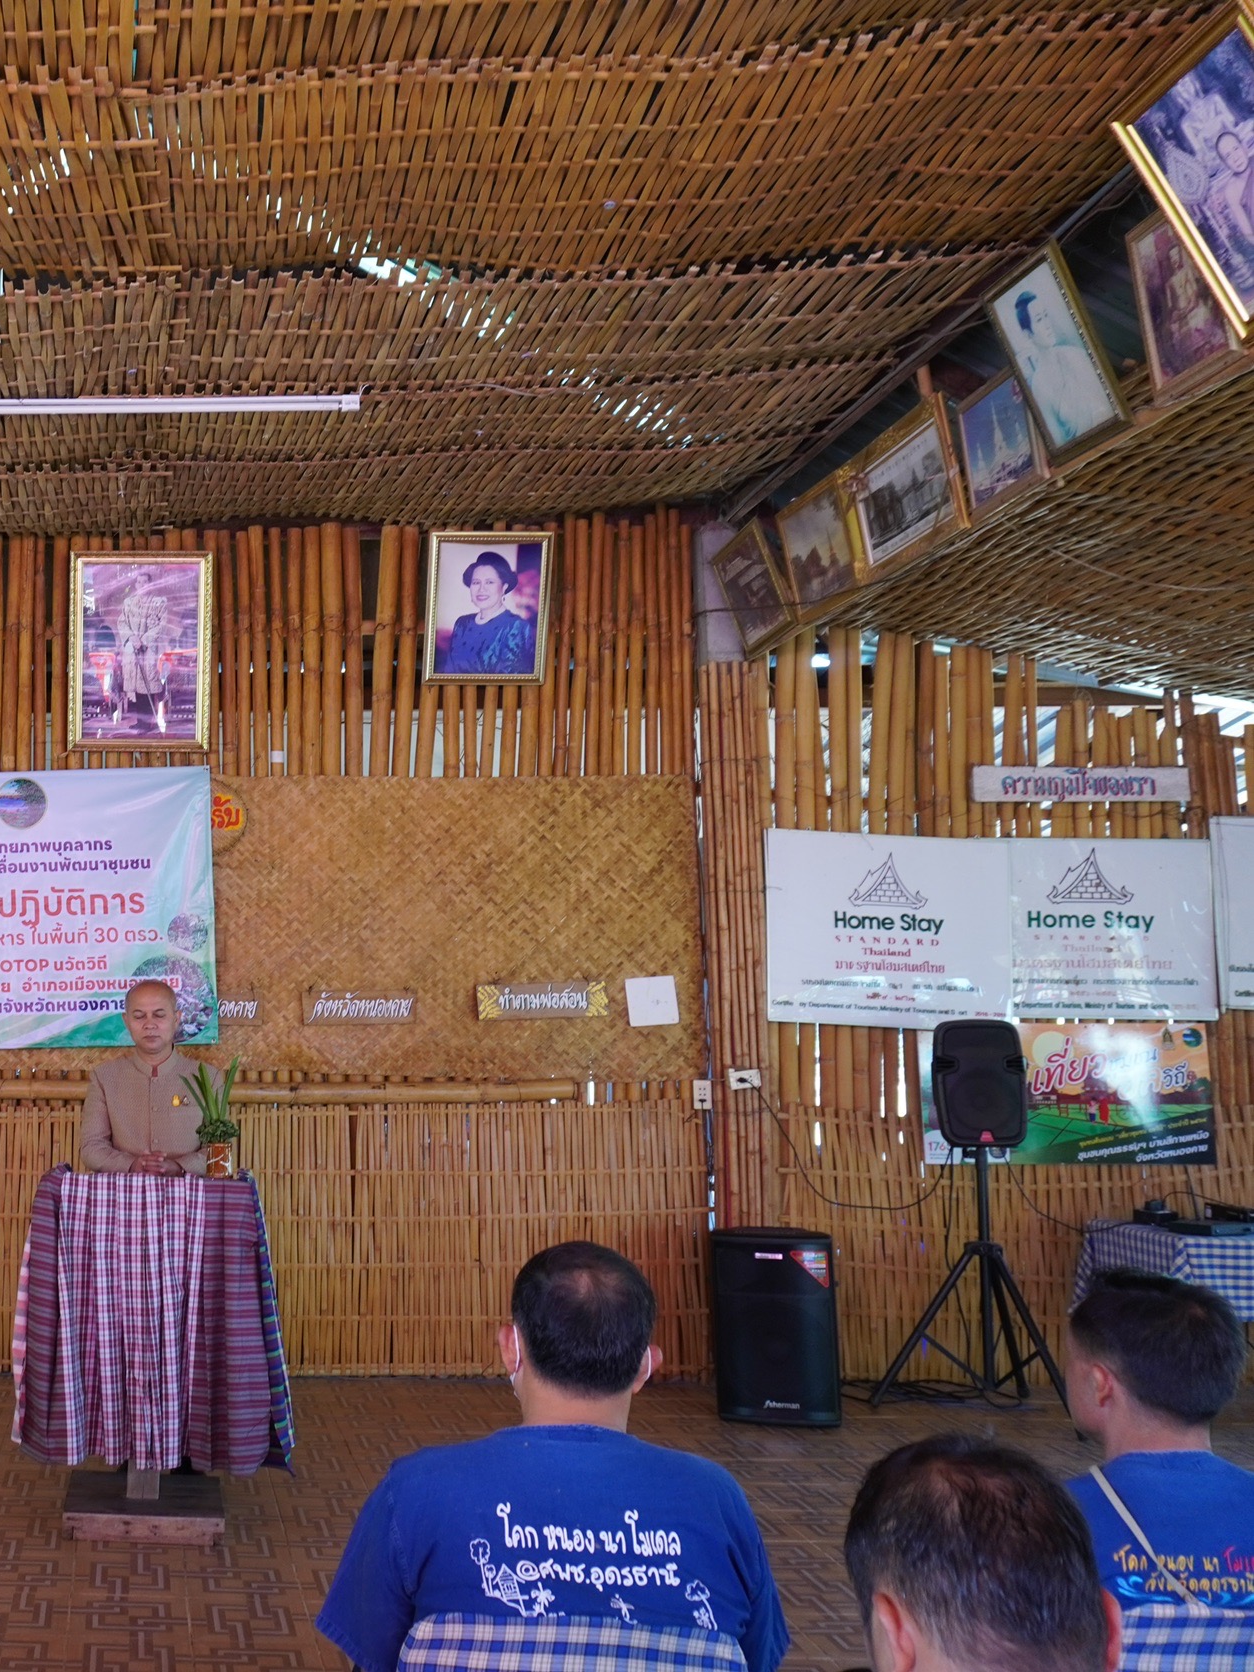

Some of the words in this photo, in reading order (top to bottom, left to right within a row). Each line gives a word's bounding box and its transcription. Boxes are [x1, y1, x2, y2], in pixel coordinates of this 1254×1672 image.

[211, 795, 241, 829] รับ
[833, 911, 896, 931] Home
[900, 913, 945, 936] Stay
[1026, 910, 1096, 929] Home
[1103, 910, 1155, 933] Stay
[31, 921, 89, 945] ในพื้นที่
[94, 927, 119, 943] 30
[834, 934, 941, 947] STANDARD
[861, 947, 912, 958] Thailand
[0, 958, 50, 973] OTOP
[53, 955, 108, 972] นวัตวิถี
[497, 984, 589, 1012] ทำตามพ่อสอน
[772, 999, 794, 1008] Certifie
[808, 1001, 845, 1011] Department
[1021, 1001, 1053, 1011] Department
[496, 1501, 539, 1549] โคก
[543, 1523, 595, 1553] หนอง
[599, 1529, 627, 1555] นา
[624, 1508, 682, 1558] โมเดล
[1202, 1556, 1220, 1574] นา
